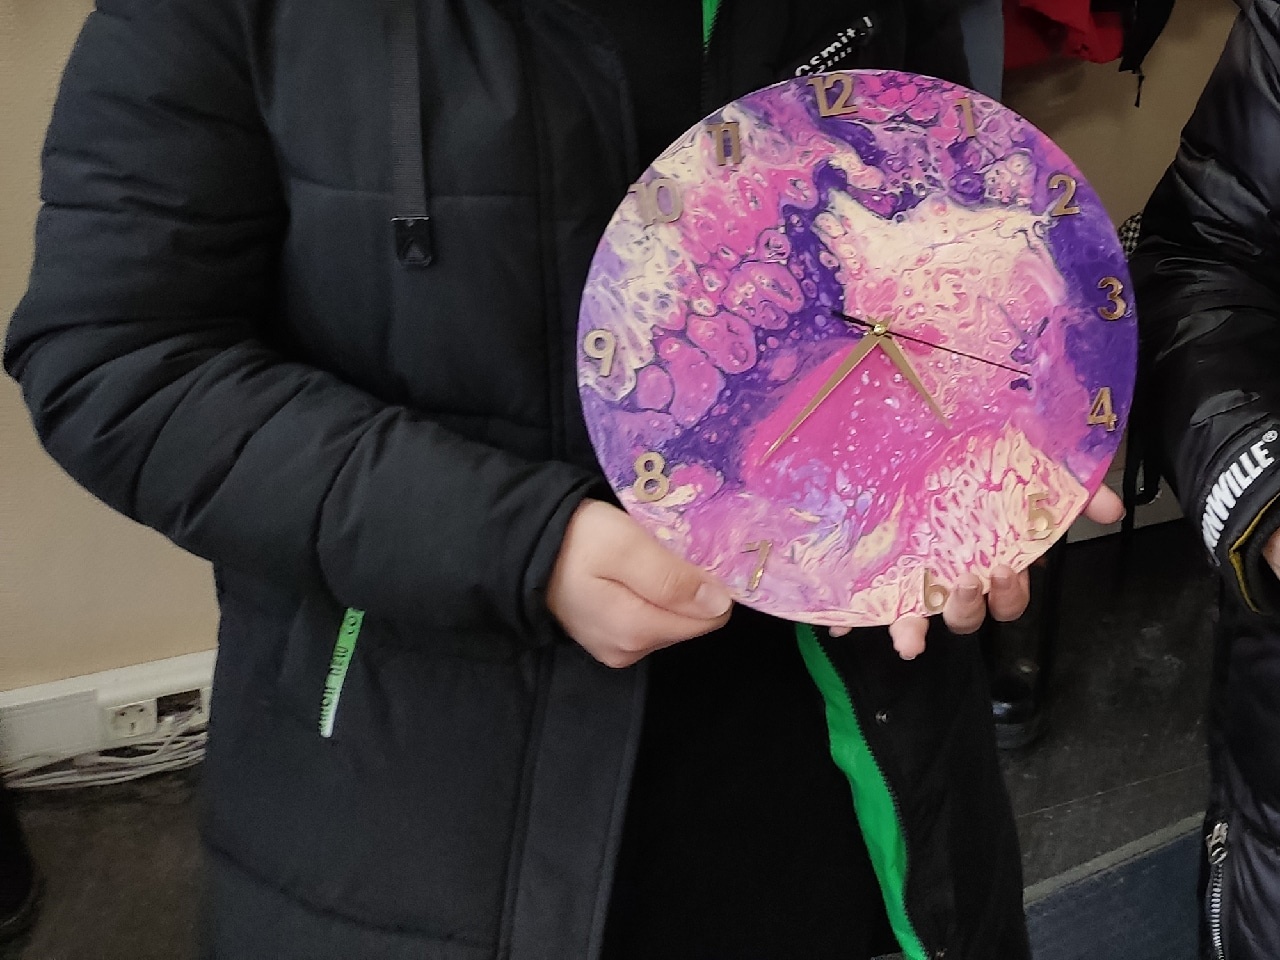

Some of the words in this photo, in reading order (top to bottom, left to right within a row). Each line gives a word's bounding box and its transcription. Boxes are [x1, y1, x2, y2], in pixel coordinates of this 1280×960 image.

[805, 73, 858, 118] 12
[956, 97, 977, 138] 1
[706, 122, 742, 166] 11
[629, 178, 682, 225] 10
[1047, 174, 1080, 217] 2
[1097, 276, 1127, 321] 3
[583, 329, 617, 377] 9
[1087, 386, 1117, 432] 4
[633, 451, 671, 504] 8
[1026, 492, 1056, 538] 5
[742, 539, 773, 591] 7
[921, 567, 948, 612] 6
